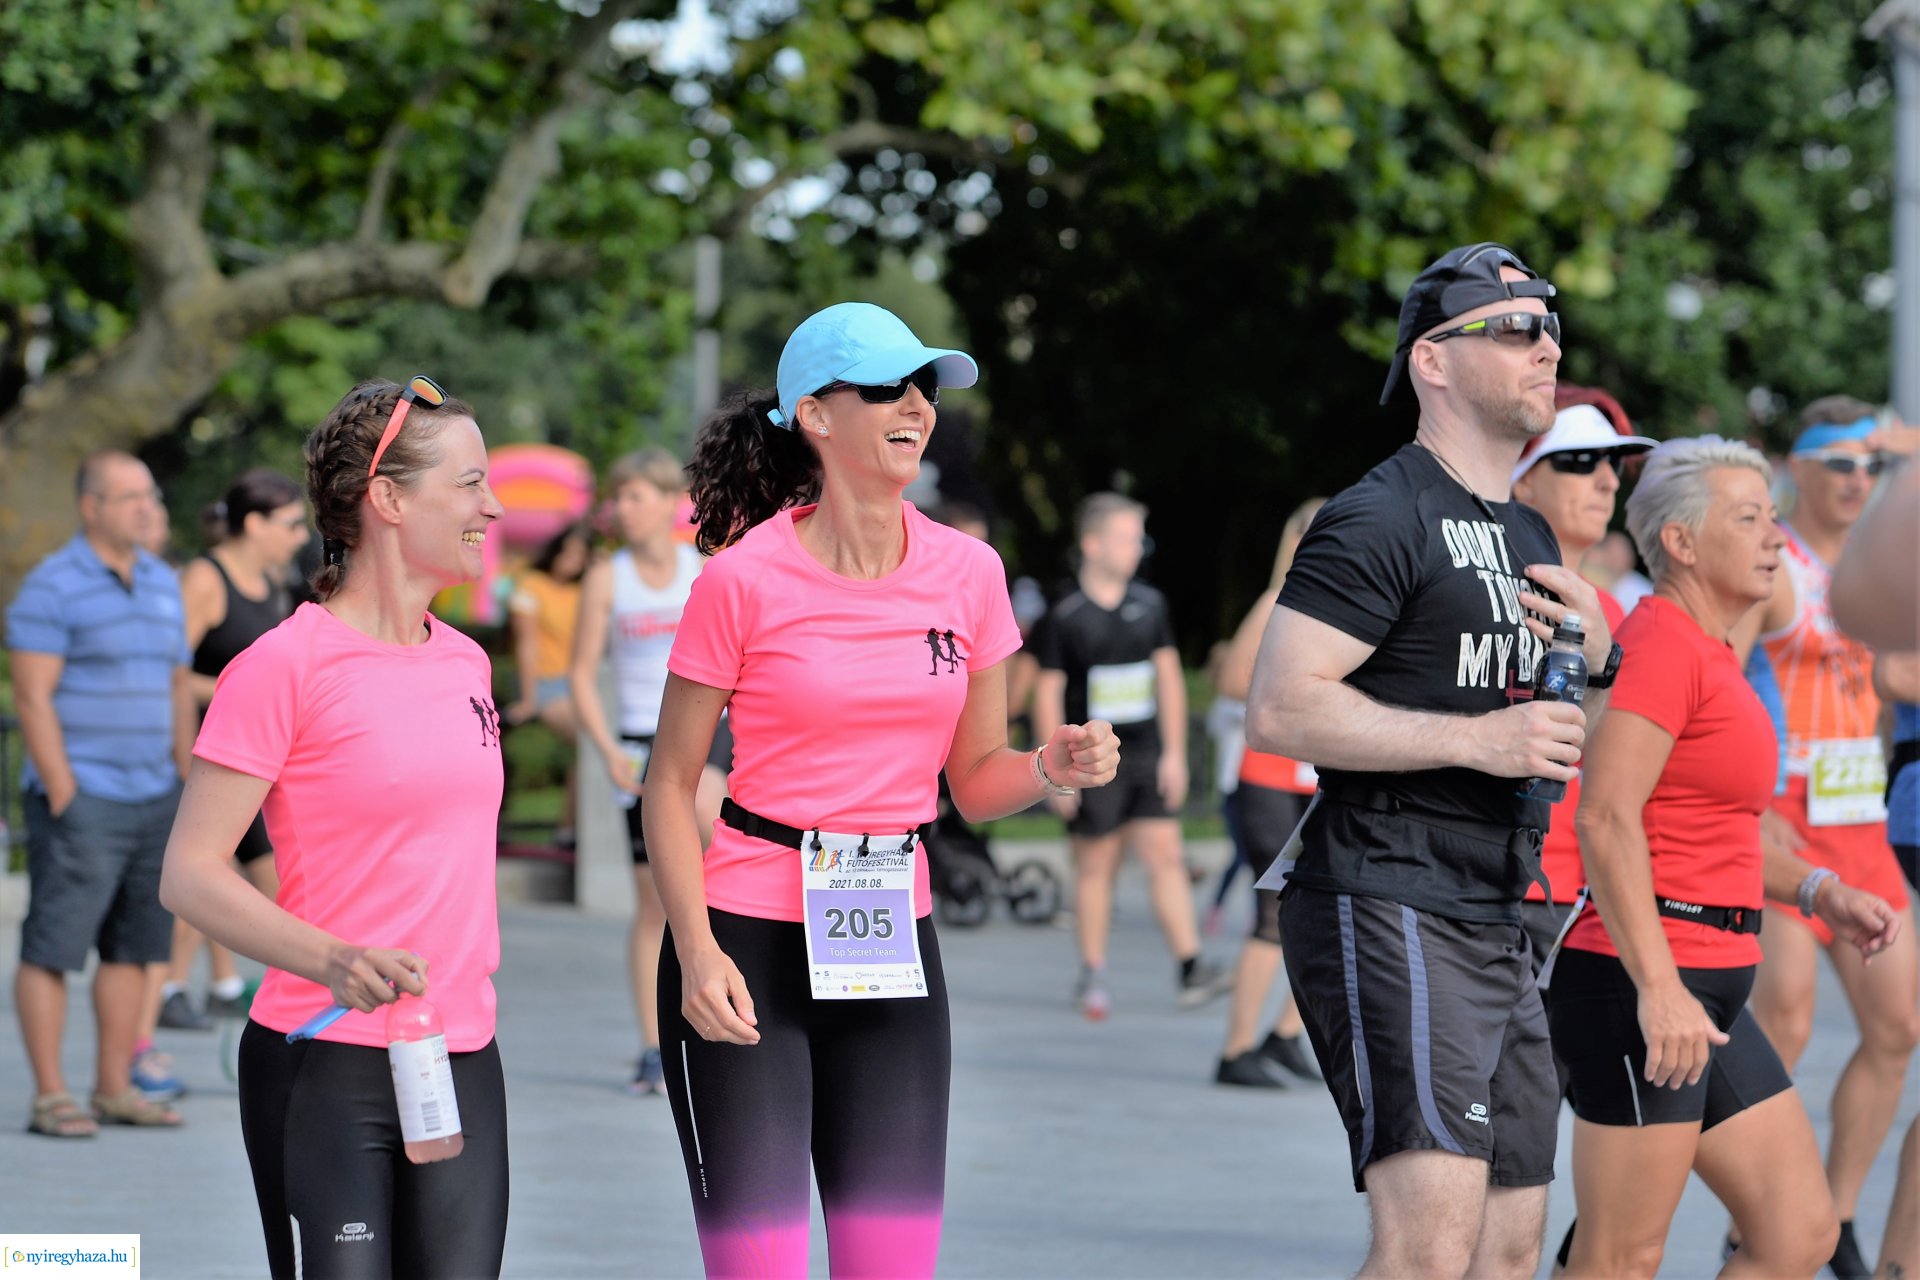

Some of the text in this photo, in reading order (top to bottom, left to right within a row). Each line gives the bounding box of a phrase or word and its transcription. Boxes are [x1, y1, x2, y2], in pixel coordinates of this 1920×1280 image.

[1457, 632, 1514, 690] MY
[846, 856, 909, 868] FUTÓFESZTIVÁL
[829, 878, 884, 889] 2021.08.08.
[824, 908, 894, 940] 205
[829, 947, 898, 958] Top Secret Team
